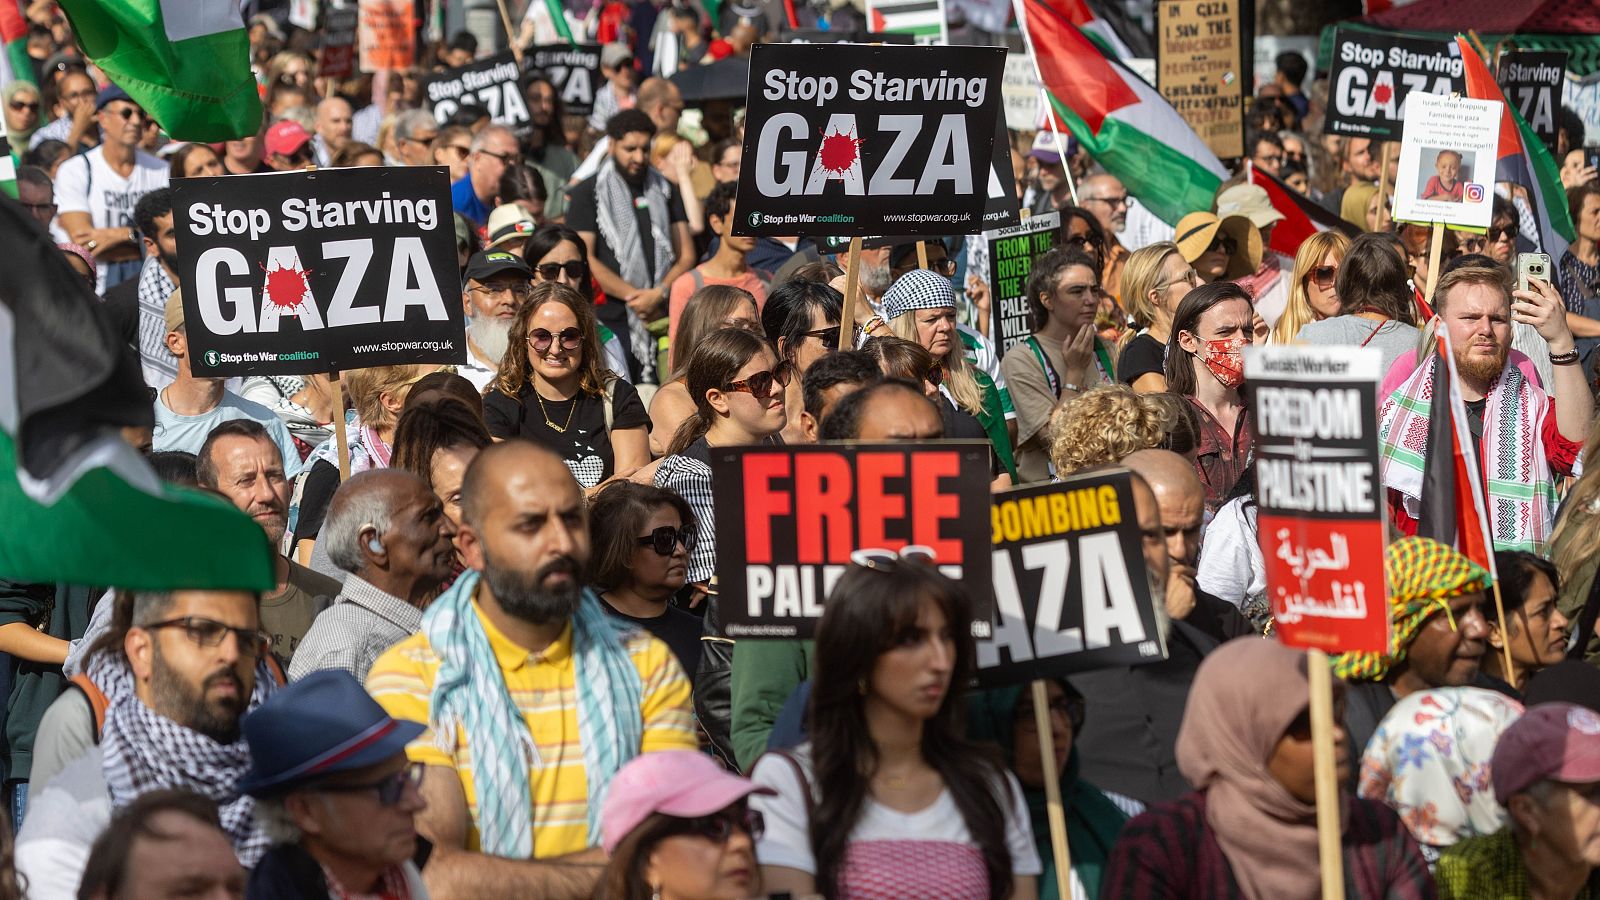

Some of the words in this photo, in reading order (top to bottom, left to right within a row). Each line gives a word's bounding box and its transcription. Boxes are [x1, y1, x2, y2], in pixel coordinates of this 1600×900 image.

[1206, 18, 1232, 35] THE
[535, 49, 599, 70] Starving
[1341, 41, 1384, 69] Stop
[1388, 46, 1463, 78] Starving
[427, 79, 464, 101] Stop
[461, 62, 520, 91] Starving
[1508, 62, 1560, 86] Starving
[763, 69, 839, 106] Stop
[848, 70, 987, 107] Starving
[1460, 103, 1488, 112] trapping
[755, 112, 974, 198] GAZA
[188, 202, 271, 241] Stop
[281, 191, 438, 231] Starving
[763, 215, 784, 226] Stop
[784, 215, 798, 224] the
[799, 214, 816, 224] War
[817, 213, 855, 224] coalition
[883, 212, 971, 225] www.stopwar.org.uk
[996, 237, 1031, 259] FROM
[195, 236, 450, 336] GAZA
[998, 277, 1022, 299] THE
[1001, 316, 1031, 338] WILL
[220, 353, 242, 365] Stop
[243, 352, 258, 362] the
[259, 351, 278, 362] War
[278, 350, 320, 361] coalition
[352, 339, 453, 355] www.stopwar.org.uk
[741, 451, 963, 565] FREE
[976, 531, 1147, 669] AZA
